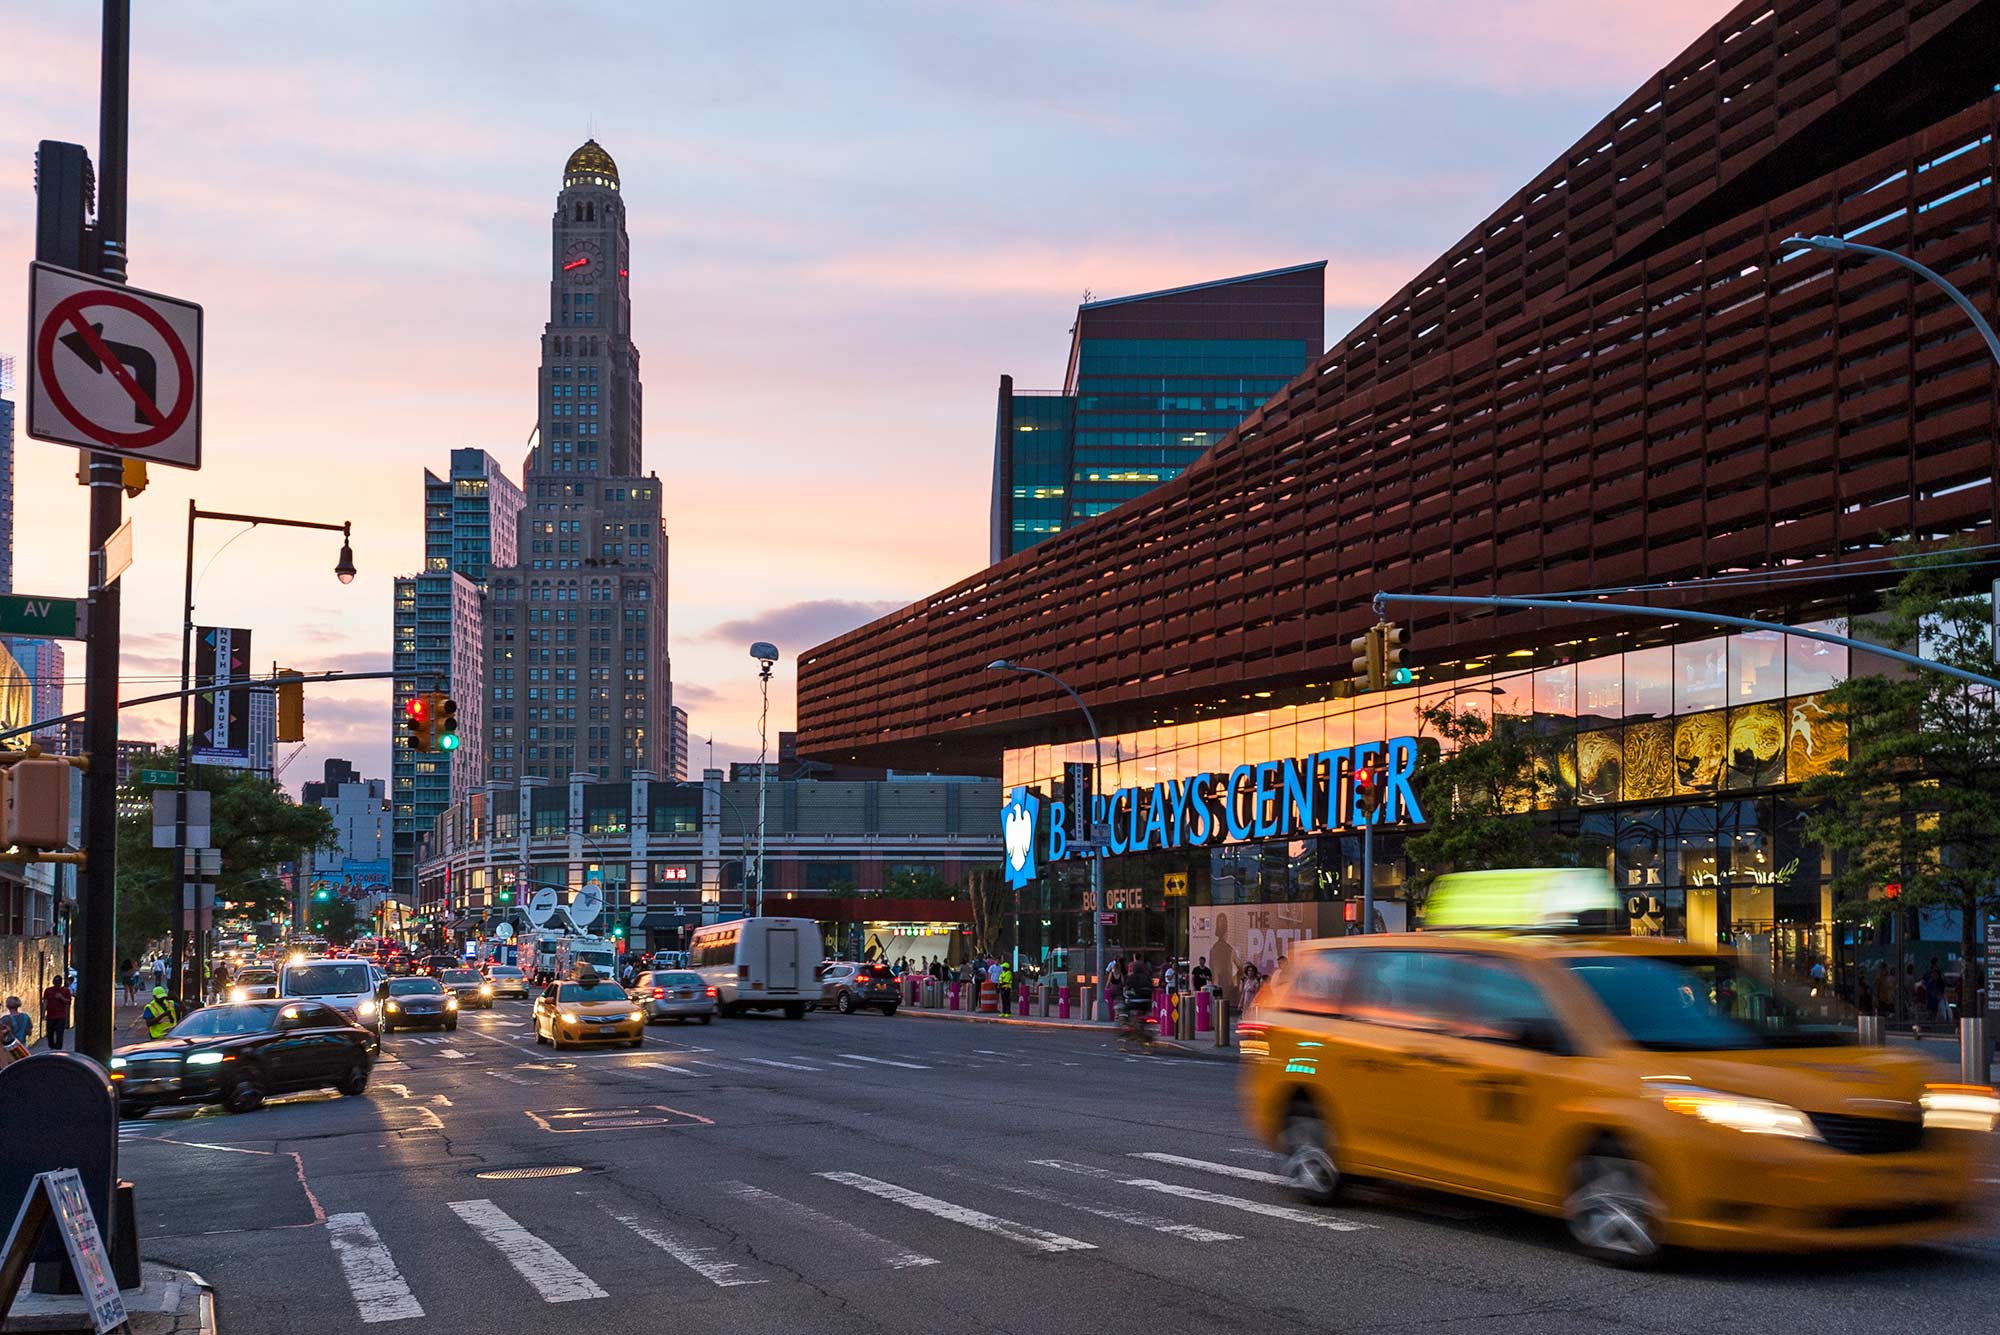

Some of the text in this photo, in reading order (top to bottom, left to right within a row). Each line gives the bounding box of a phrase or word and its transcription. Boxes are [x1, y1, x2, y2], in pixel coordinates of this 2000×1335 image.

[23, 600, 52, 618] AV
[219, 629, 228, 668] NORTH
[217, 674, 226, 738] FATBUSH
[150, 772, 158, 784] 5
[1225, 735, 1426, 840] CENTER
[1082, 887, 1143, 911] BO OFFICE
[1247, 911, 1270, 928] THE
[1247, 927, 1313, 970] PAT
